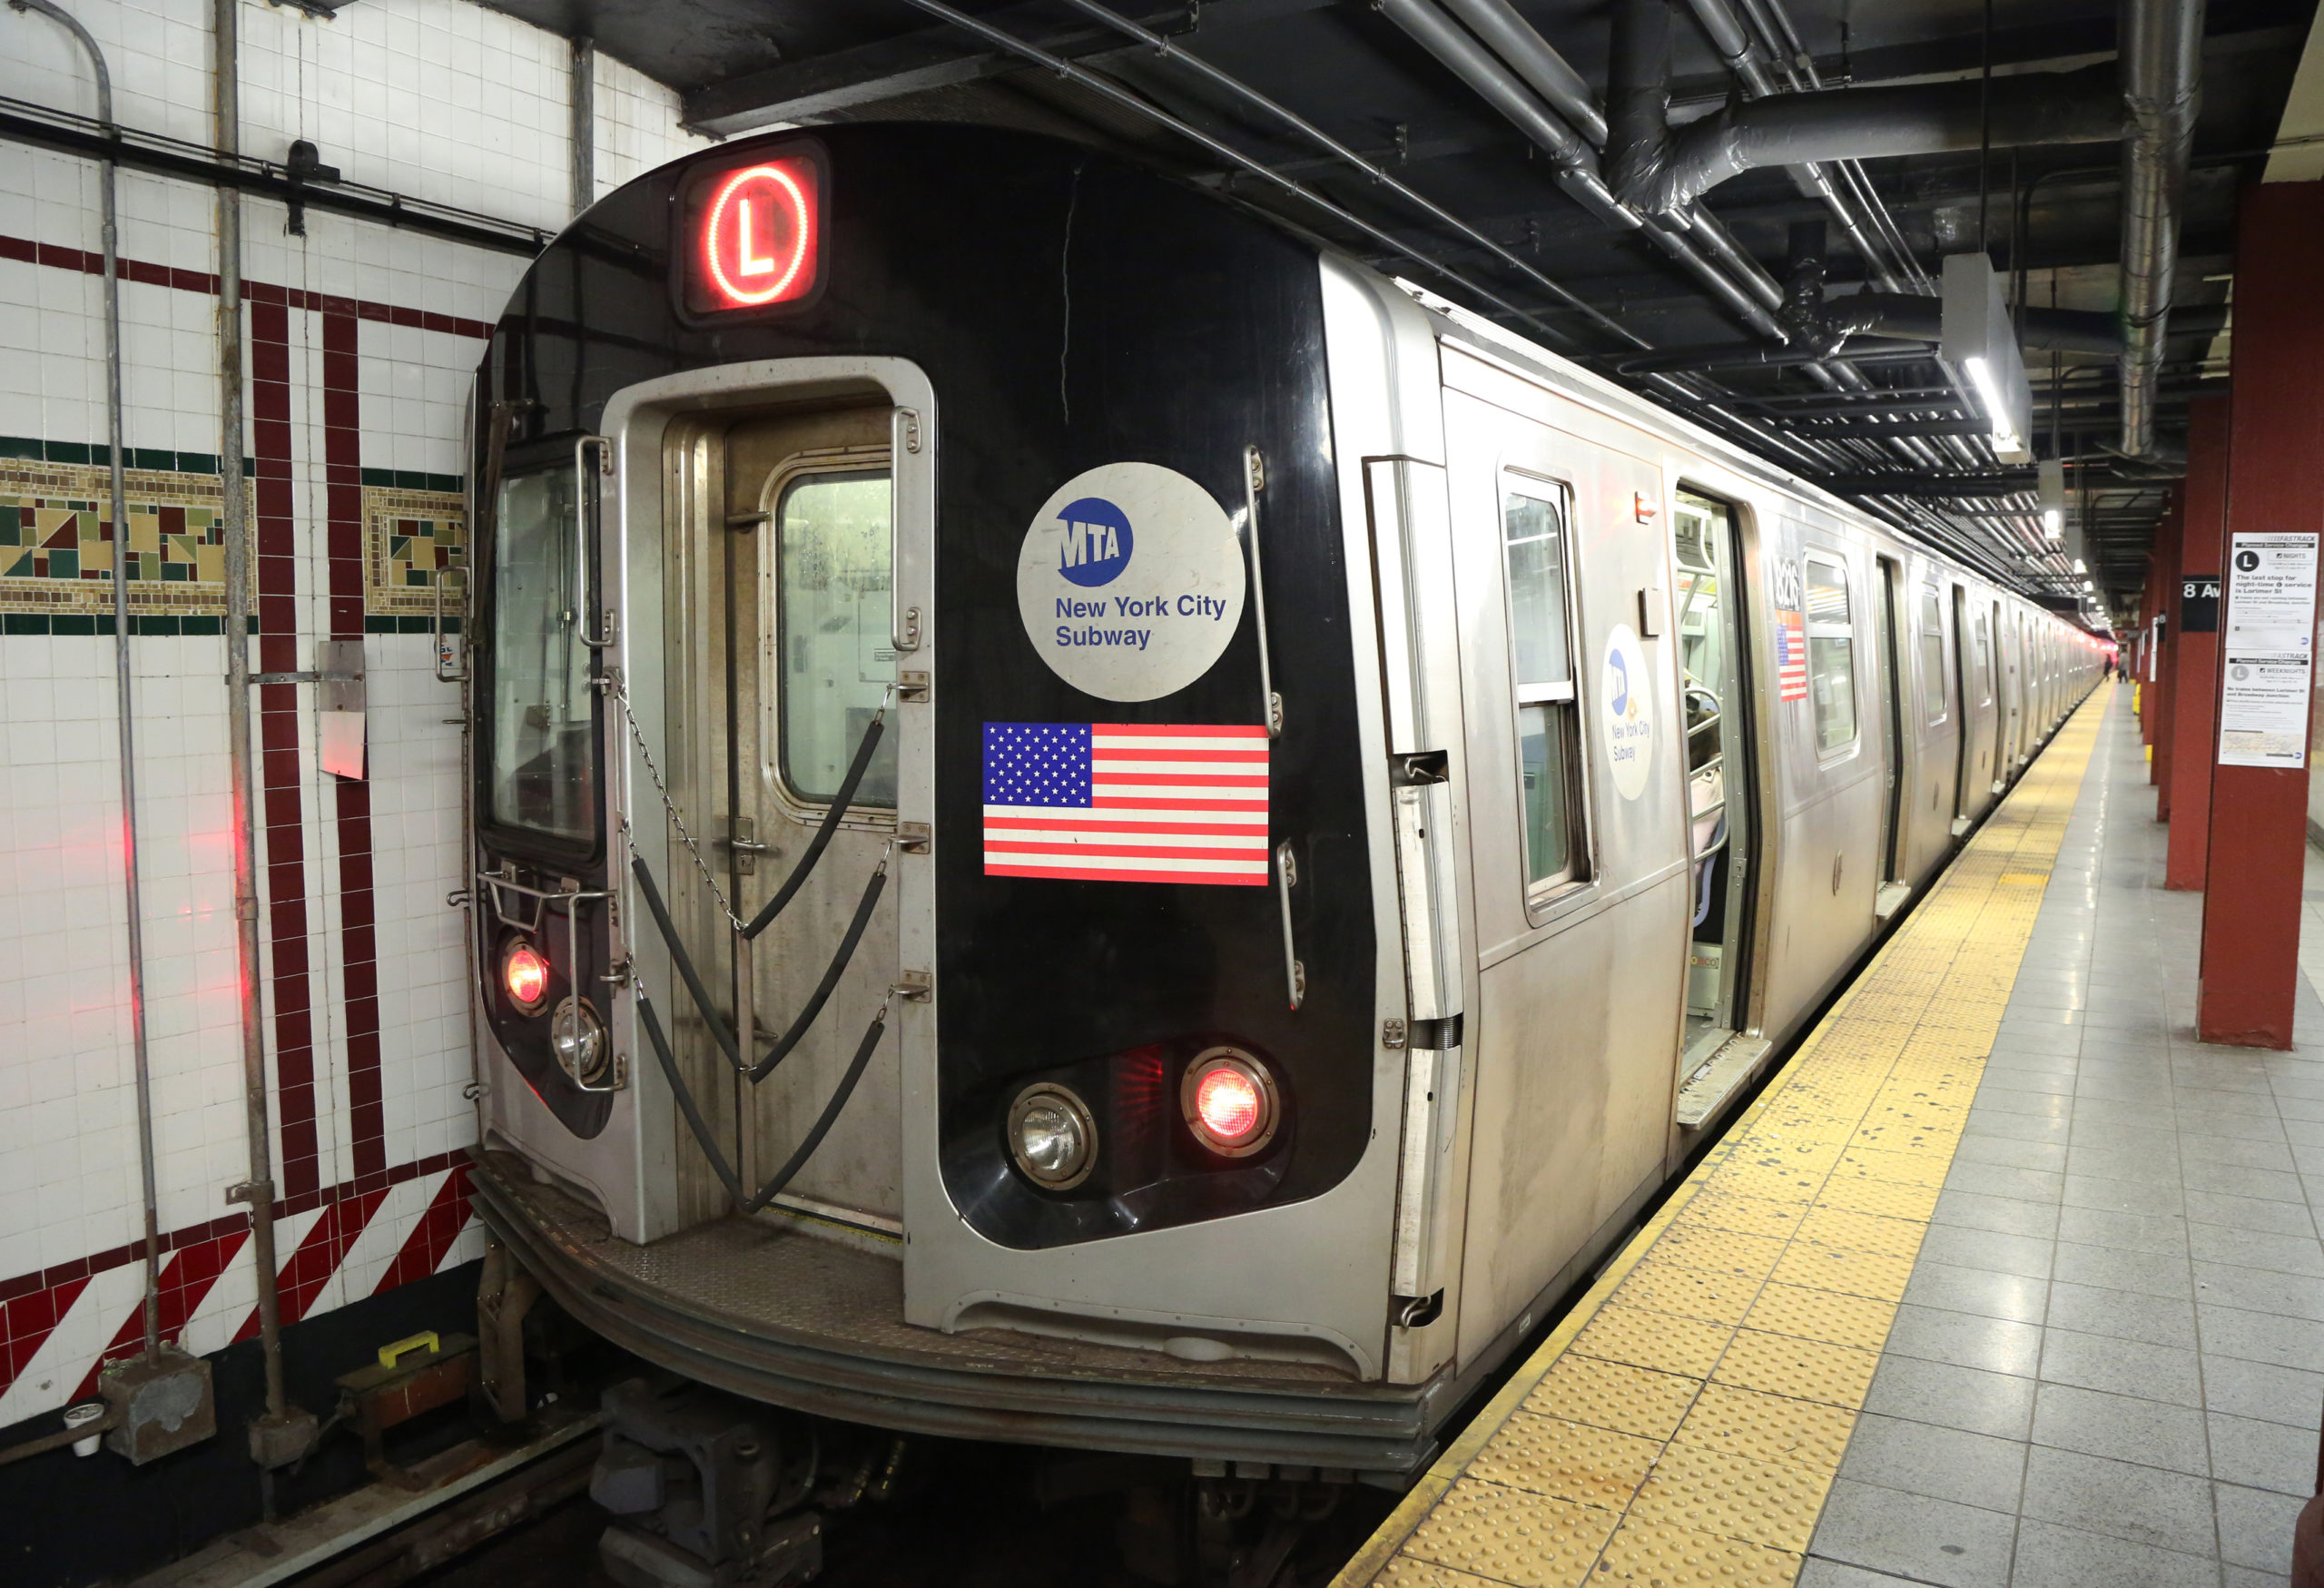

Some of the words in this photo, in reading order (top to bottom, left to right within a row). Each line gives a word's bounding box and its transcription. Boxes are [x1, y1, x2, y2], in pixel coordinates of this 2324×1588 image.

[740, 199, 774, 277] L
[1057, 518, 1120, 569] MTA
[2243, 555, 2252, 567] L
[2183, 584, 2196, 597] 8
[1056, 597, 1107, 618] New
[1115, 596, 1169, 617] York
[1177, 595, 1226, 621] City
[1056, 626, 1151, 651] Subway
[2236, 668, 2243, 677] L
[1612, 725, 1625, 740] New
[1626, 722, 1639, 737] York
[1639, 720, 1650, 738] City
[1613, 745, 1636, 762] Subway
